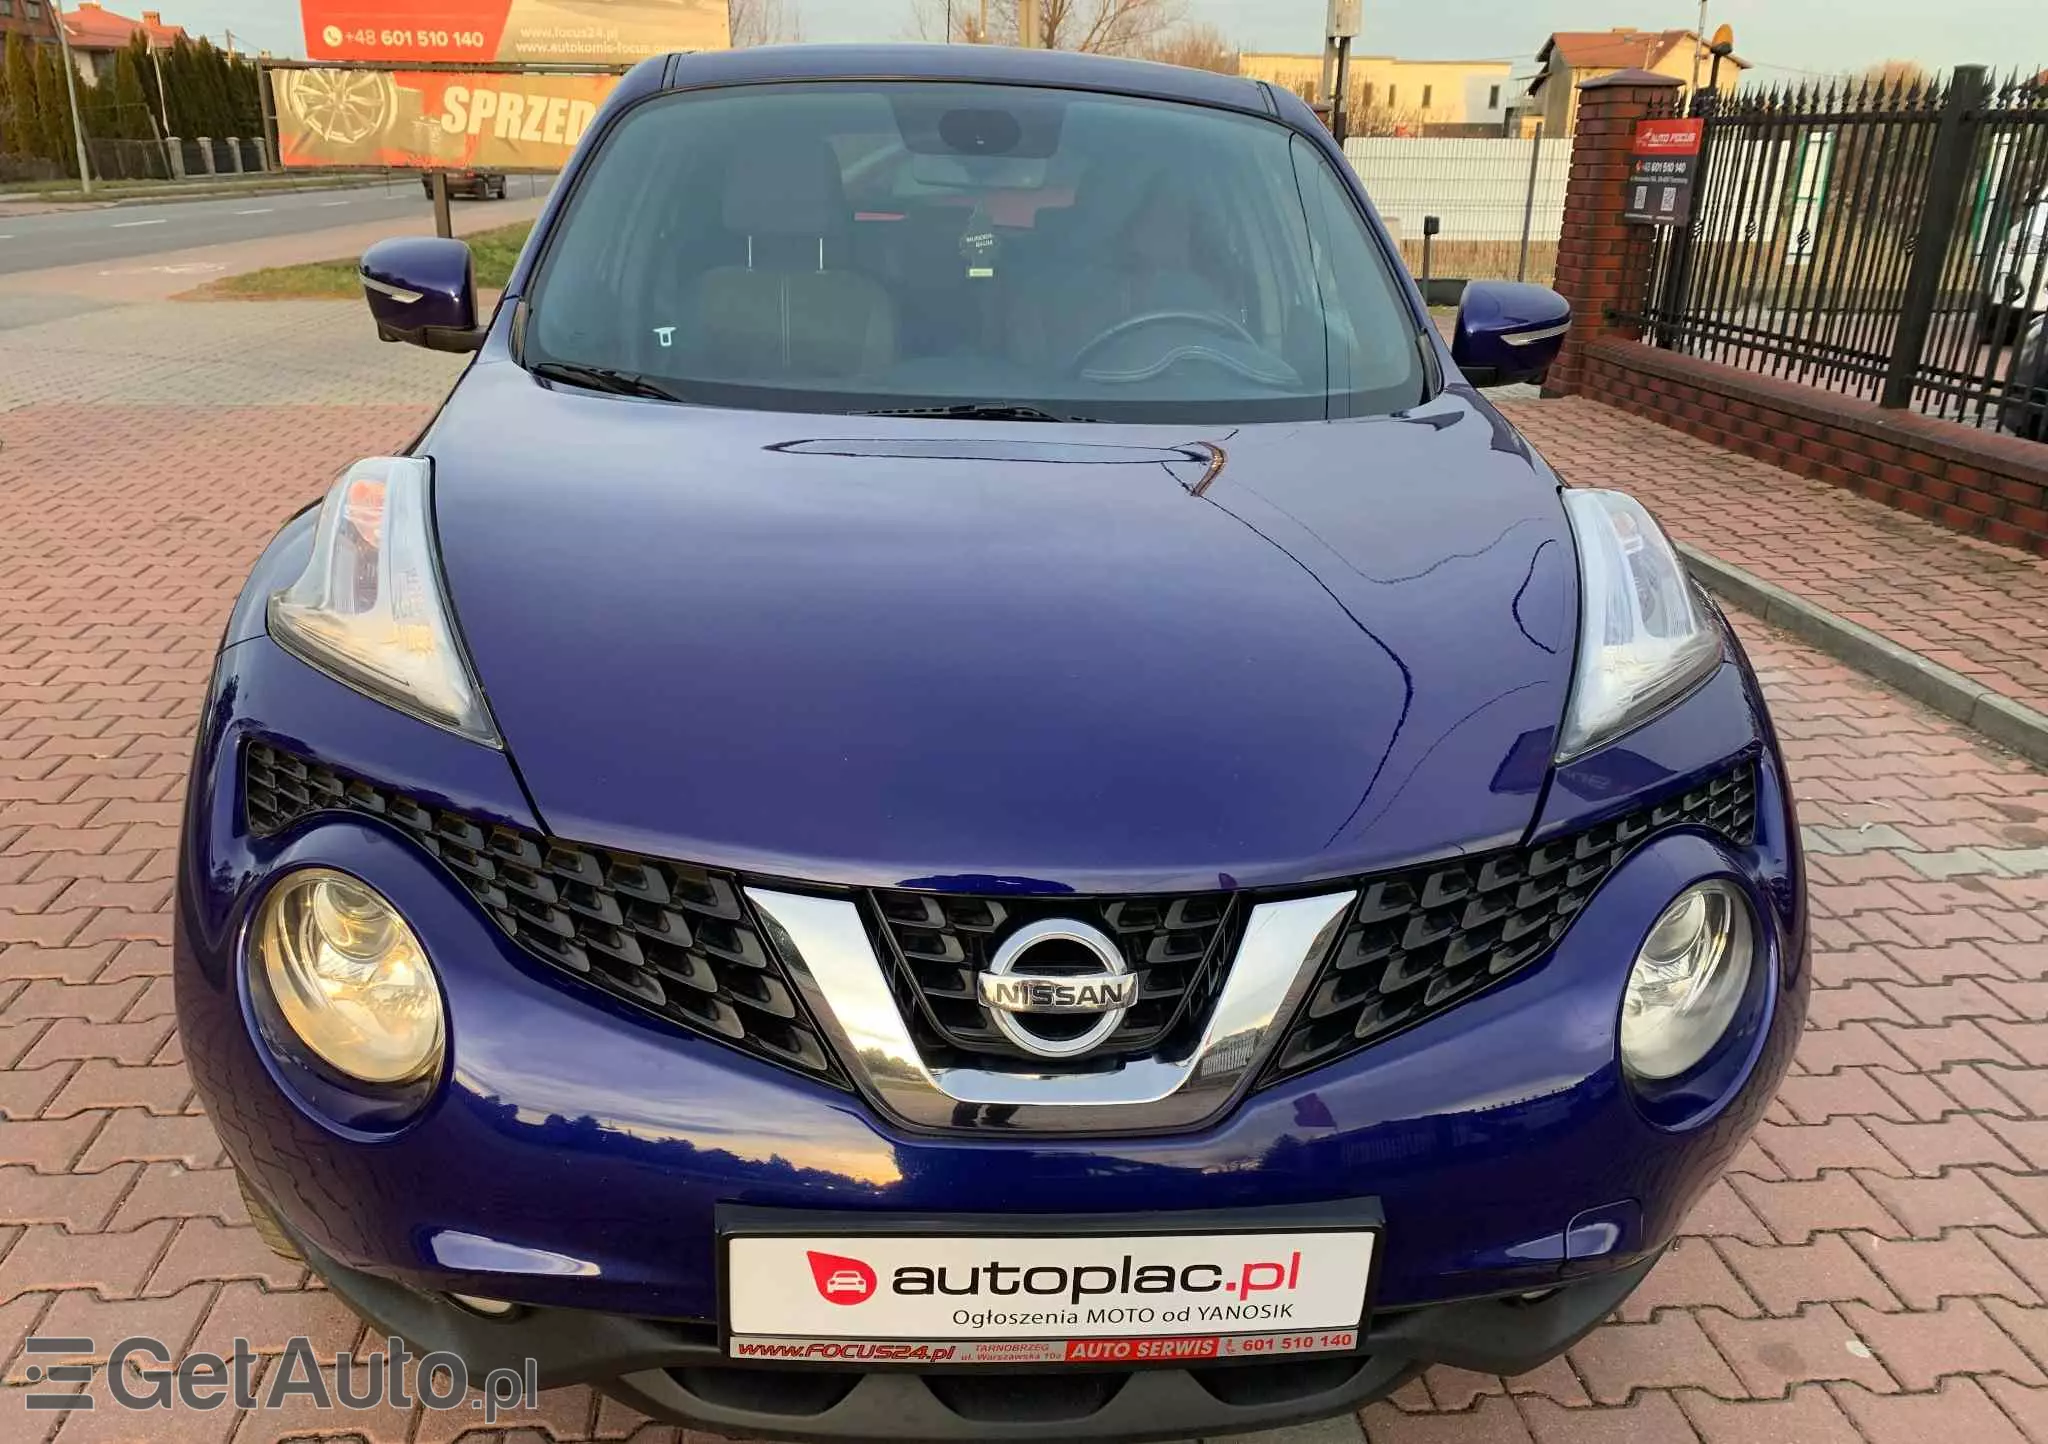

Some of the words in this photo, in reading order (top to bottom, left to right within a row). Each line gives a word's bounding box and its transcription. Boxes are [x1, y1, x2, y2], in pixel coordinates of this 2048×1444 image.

[345, 29, 377, 46] +48
[380, 30, 413, 47] 601
[416, 30, 449, 47] 510
[452, 31, 484, 48] 140
[520, 26, 618, 41] www.focus24.pl
[996, 983, 1122, 1006] NISSAN
[892, 1251, 1301, 1305] autoplac.pl
[952, 1307, 1081, 1329] Ogłoszenia
[1087, 1308, 1155, 1325] MOTO
[1162, 1305, 1190, 1322] od
[1197, 1303, 1294, 1321] YANOSIK
[975, 1343, 1050, 1352] TARNOBRZEG
[1070, 1341, 1131, 1359] AUTO
[1135, 1338, 1214, 1358] SERWIS
[1242, 1339, 1274, 1351] 601
[1280, 1337, 1313, 1349] 510
[1319, 1334, 1353, 1347] 140
[738, 1343, 956, 1362] www.FOCUS24.pl
[961, 1352, 974, 1361] ul.
[977, 1352, 1041, 1360] Warszawska
